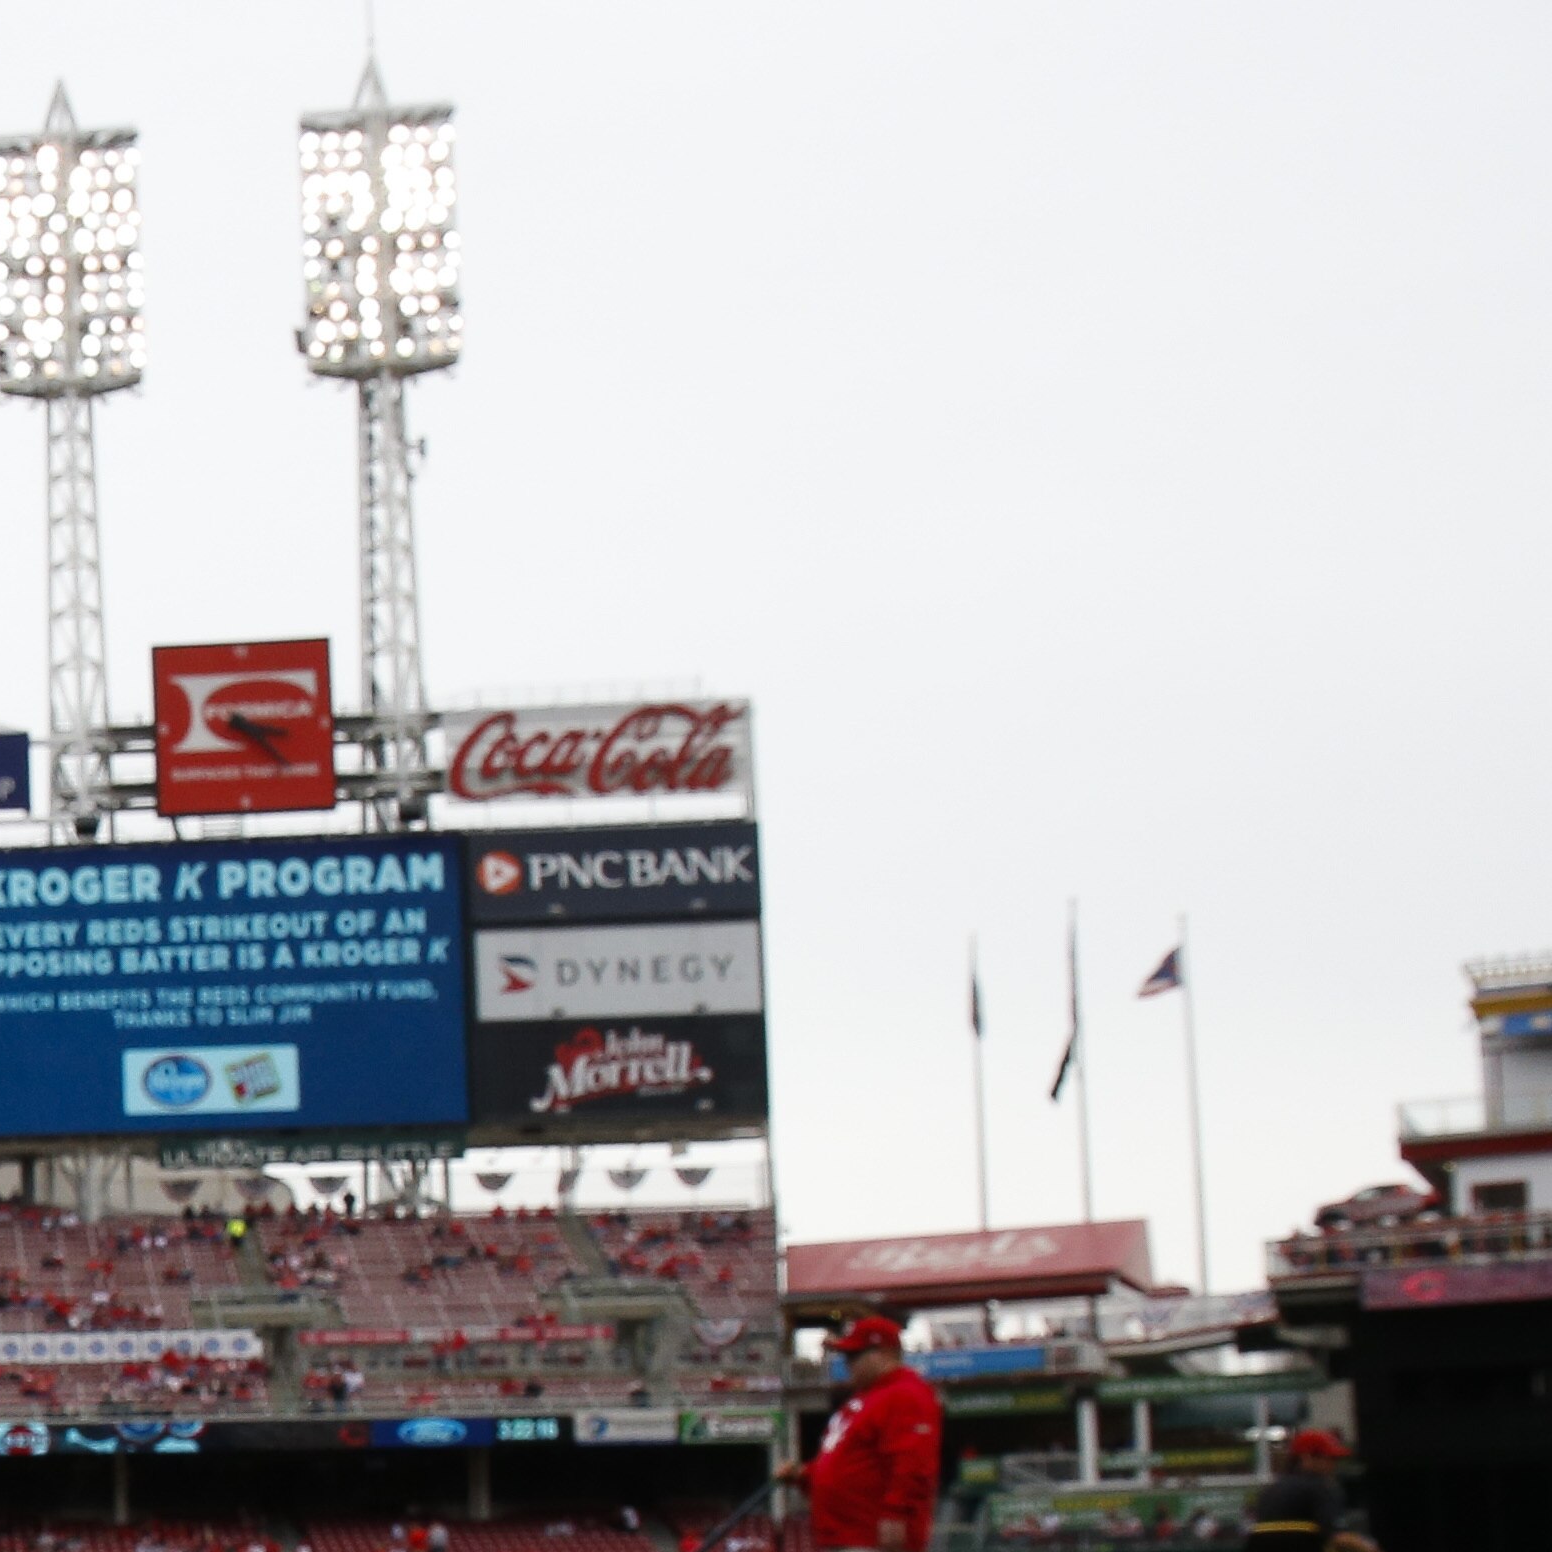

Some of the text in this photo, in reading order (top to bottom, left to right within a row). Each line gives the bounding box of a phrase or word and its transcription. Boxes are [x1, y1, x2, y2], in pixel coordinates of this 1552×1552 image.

[449, 703, 745, 800] Coca-Cola
[173, 861, 208, 901] K
[217, 852, 445, 900] PROGRAM
[86, 917, 163, 945] REDS
[168, 911, 329, 944] STRIKEOUT
[334, 908, 377, 938] OF
[382, 906, 428, 936] AN
[119, 945, 231, 975] BATTER
[237, 943, 267, 971] IS
[272, 941, 296, 970] A
[301, 937, 423, 969] KROGER
[426, 935, 452, 964] K
[555, 953, 734, 987] DYNEGY
